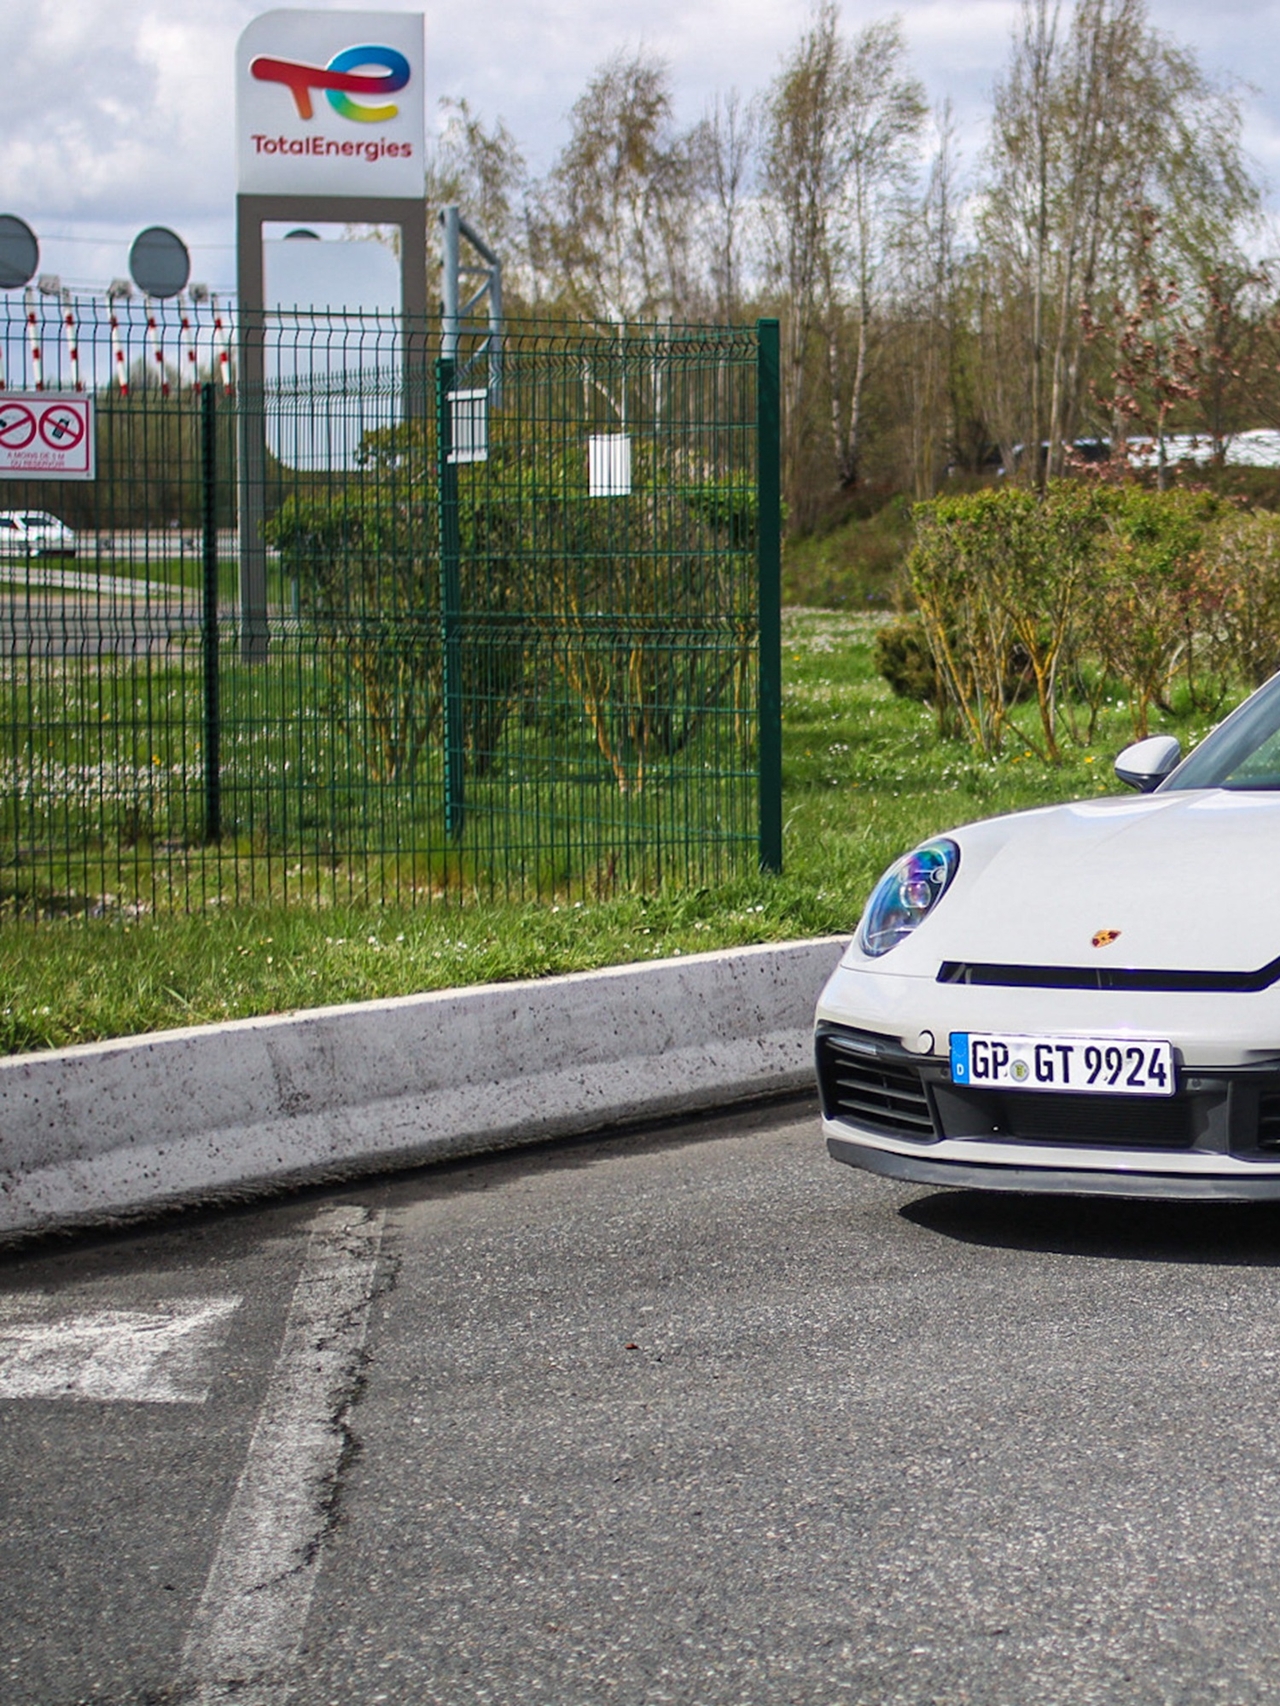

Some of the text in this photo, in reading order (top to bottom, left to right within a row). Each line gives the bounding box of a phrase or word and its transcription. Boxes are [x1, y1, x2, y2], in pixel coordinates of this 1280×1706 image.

[251, 135, 412, 162] TotalEnergies
[972, 1041, 1009, 1080] GP
[1034, 1044, 1074, 1084] GT
[1084, 1046, 1168, 1087] 9924
